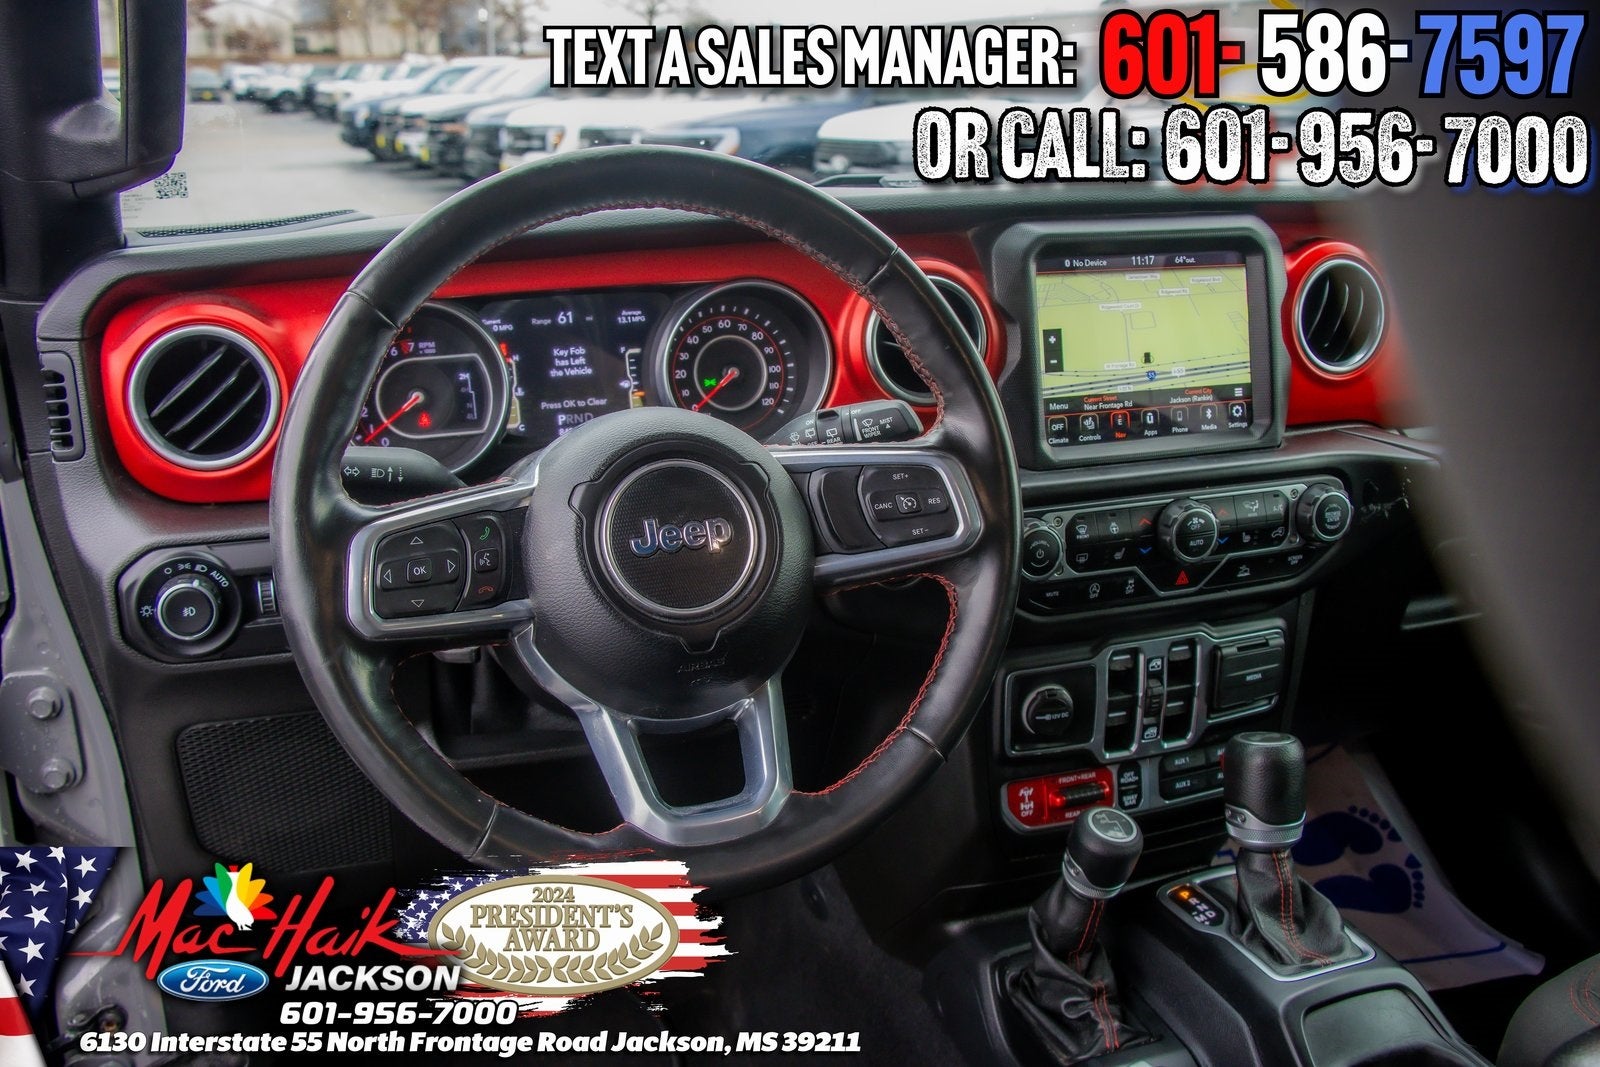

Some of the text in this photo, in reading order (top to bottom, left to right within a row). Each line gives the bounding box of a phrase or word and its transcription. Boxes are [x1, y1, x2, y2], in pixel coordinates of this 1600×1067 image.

[1073, 258, 1107, 267] No Device
[1131, 255, 1155, 266] 11:17
[532, 317, 551, 326] Range
[557, 311, 574, 324] 61
[718, 320, 731, 328] 60
[738, 323, 748, 331] 70
[702, 325, 713, 333] 50
[687, 336, 699, 344] 40
[752, 332, 764, 340] 80
[408, 342, 415, 352] 7
[390, 347, 398, 356] 6
[553, 347, 586, 358] Key Fob
[555, 357, 586, 367] has Left
[550, 366, 593, 377] the Vehicle
[675, 370, 687, 379] 20
[541, 401, 561, 410] Press
[563, 400, 576, 408] OK
[587, 398, 608, 406] Clear
[1169, 396, 1191, 404] Jackson
[1099, 402, 1123, 410] Frontage
[361, 407, 368, 417] 2
[879, 416, 894, 425] MIST
[1051, 423, 1064, 431] OFF
[1228, 421, 1248, 429] Settings
[862, 426, 880, 434] FRONT
[863, 431, 881, 439] WIPER
[1079, 434, 1101, 442] Controls
[381, 437, 389, 447] 0
[928, 497, 941, 505] RES
[874, 502, 893, 510] CANC
[630, 516, 732, 558] Jeep
[1189, 539, 1204, 547] AUTO
[413, 565, 427, 575] OK
[209, 570, 230, 588] AUTO
[1246, 673, 1262, 681] MEDIA
[1174, 758, 1186, 766] AUX
